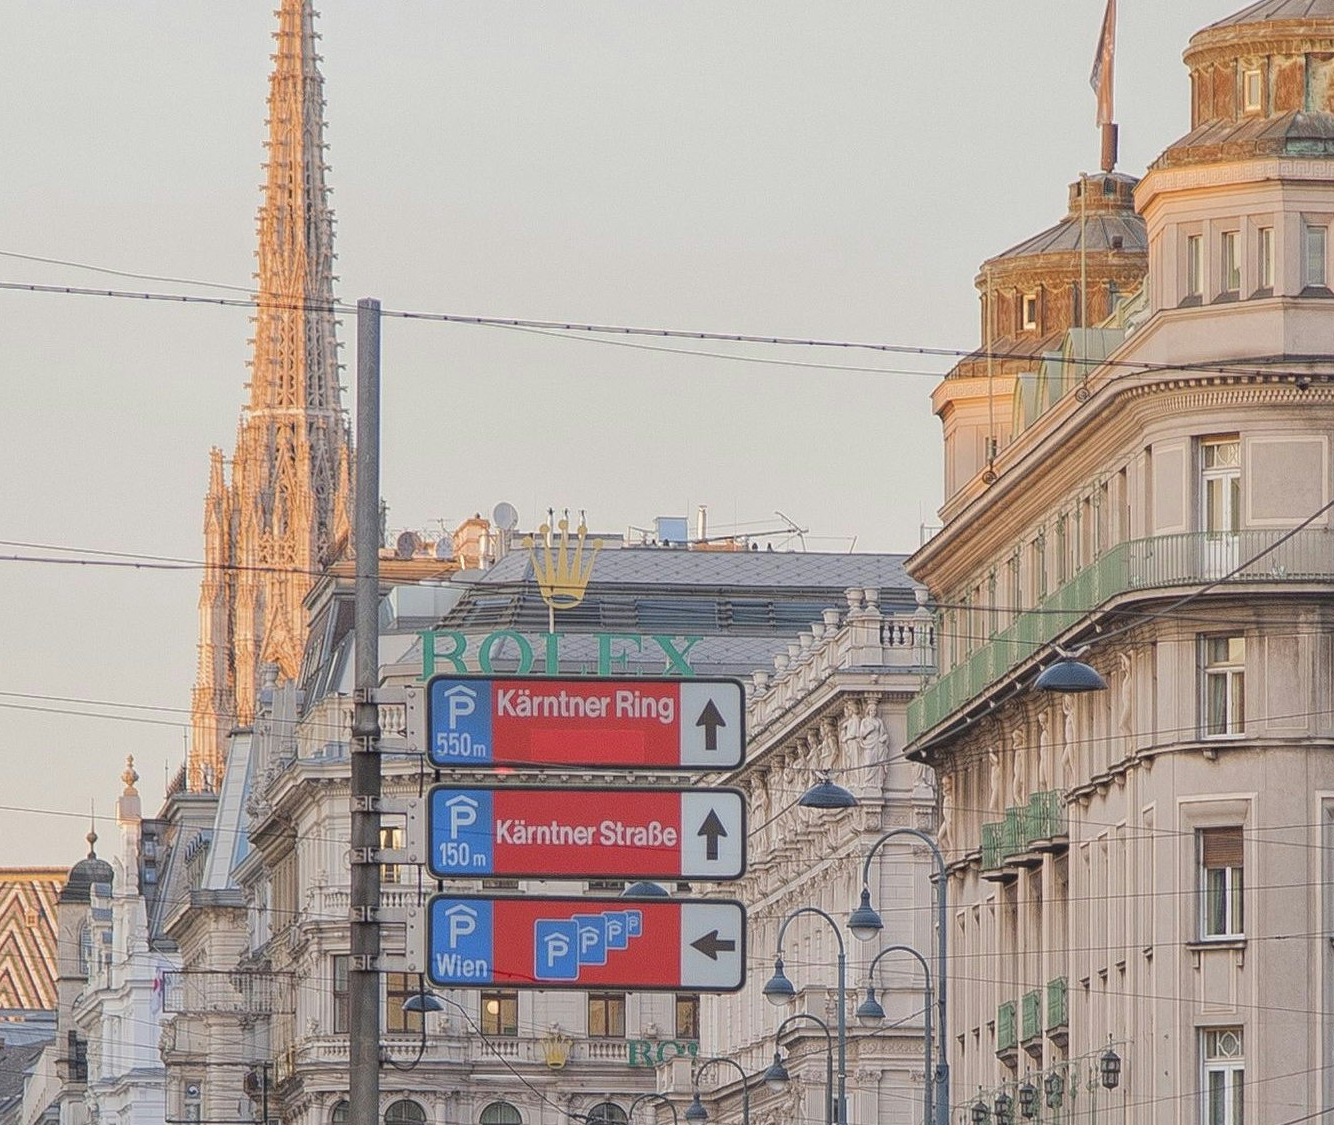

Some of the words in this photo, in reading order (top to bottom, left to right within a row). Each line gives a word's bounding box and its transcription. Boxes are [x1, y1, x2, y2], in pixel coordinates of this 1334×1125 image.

[415, 629, 705, 681] ROLEX
[497, 689, 610, 718] Kärntner
[615, 689, 675, 724] Ring
[495, 819, 596, 845] Kärntner
[599, 820, 678, 847] Straße
[436, 953, 488, 977] Wien
